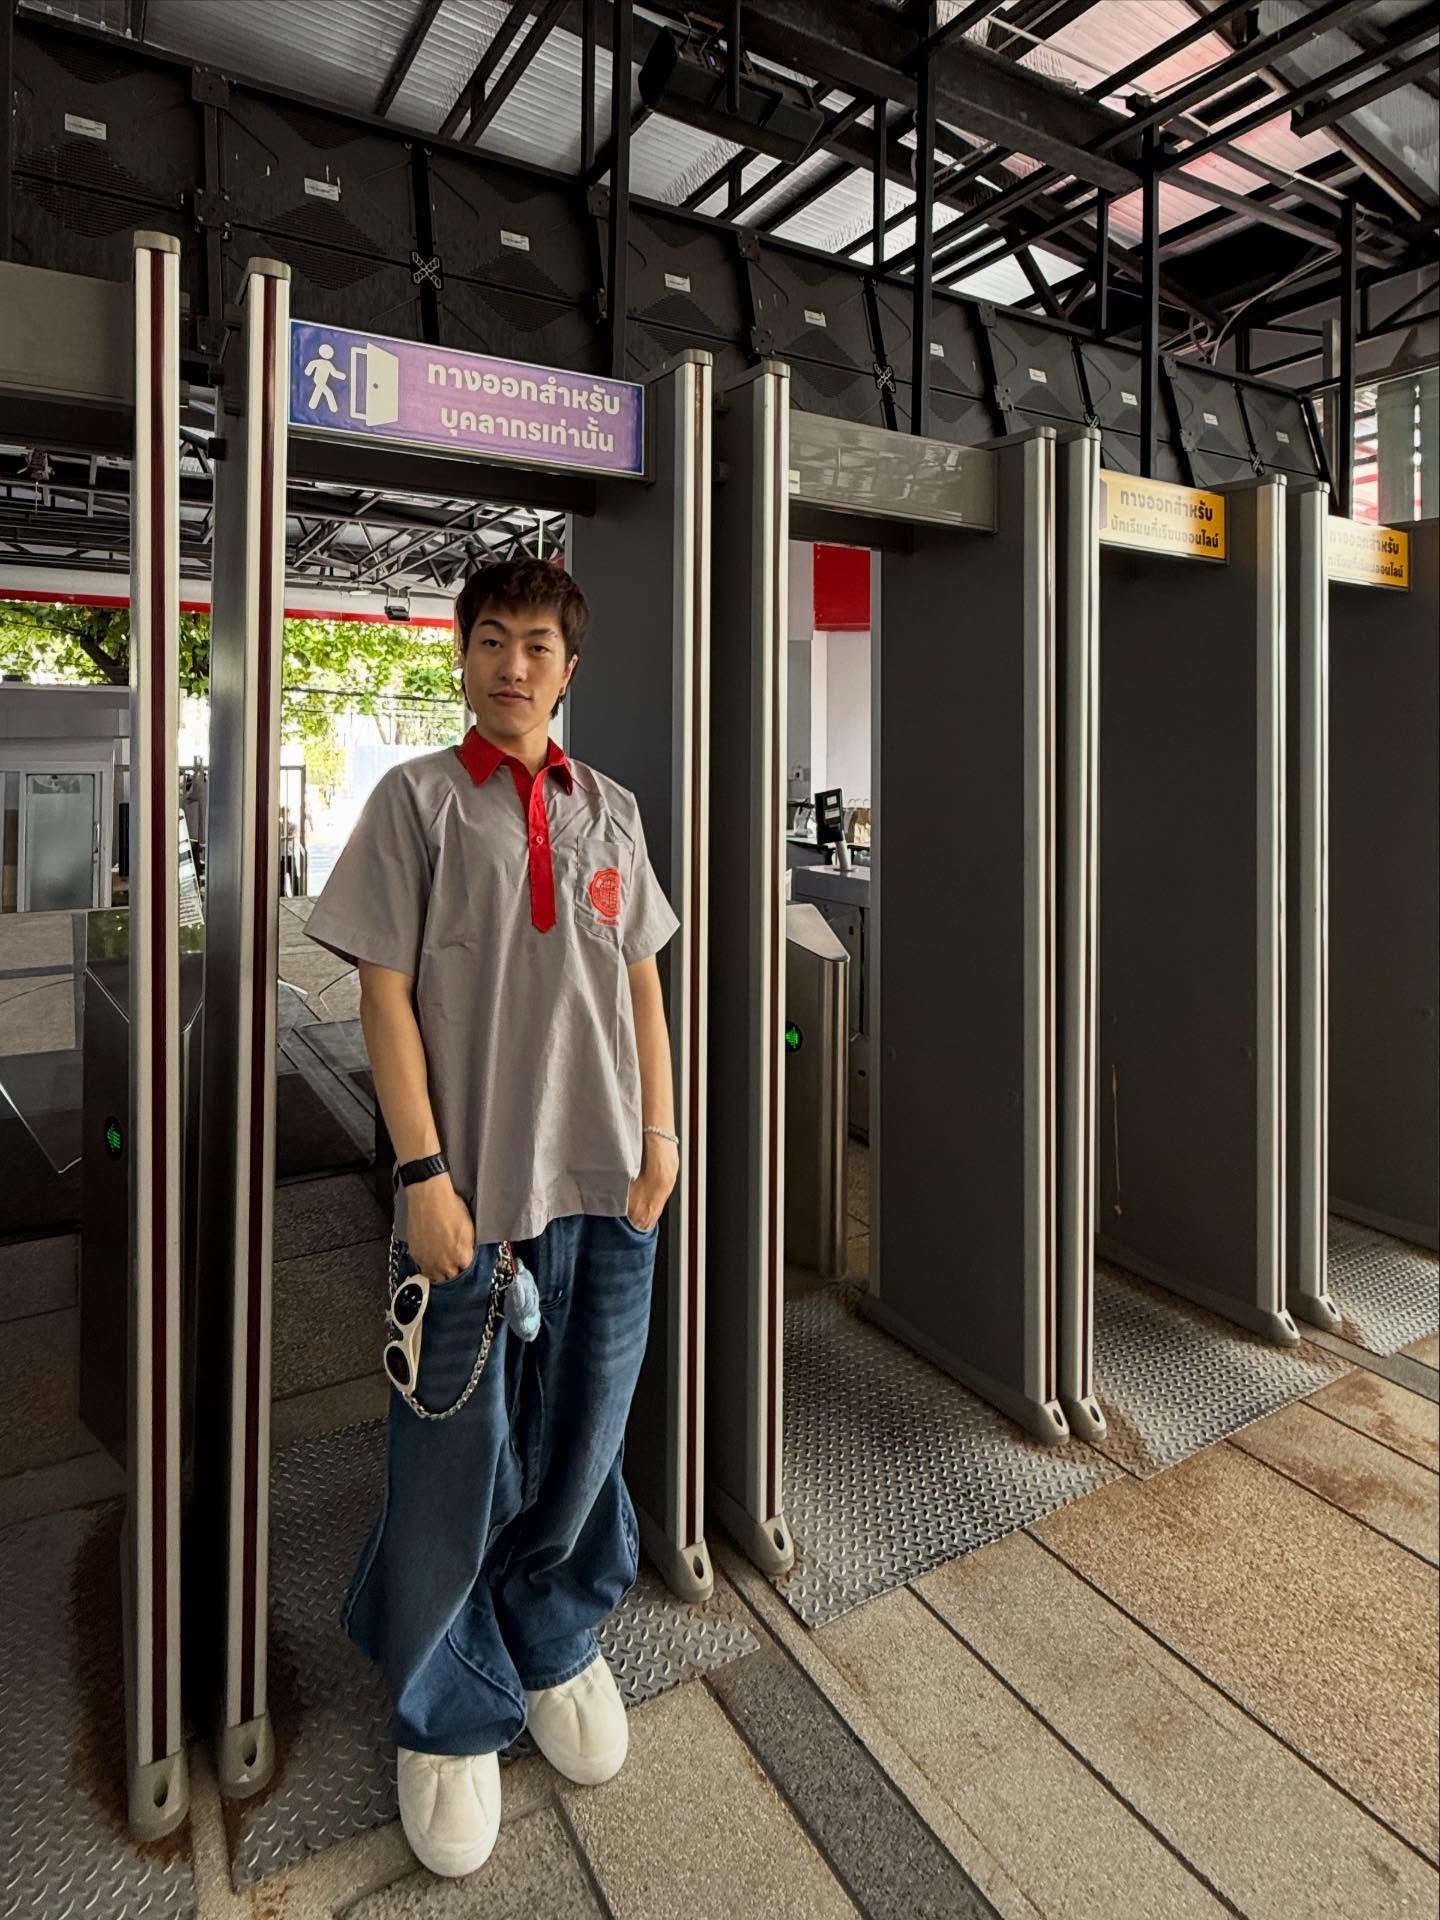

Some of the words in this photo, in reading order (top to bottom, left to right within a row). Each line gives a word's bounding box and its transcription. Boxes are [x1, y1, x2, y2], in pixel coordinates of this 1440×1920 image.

[428, 363, 620, 414] ทางออกสำหรับ
[441, 408, 614, 452] บุคลากรเท่านั้น
[1120, 489, 1213, 521] ทางออกสำหรับ
